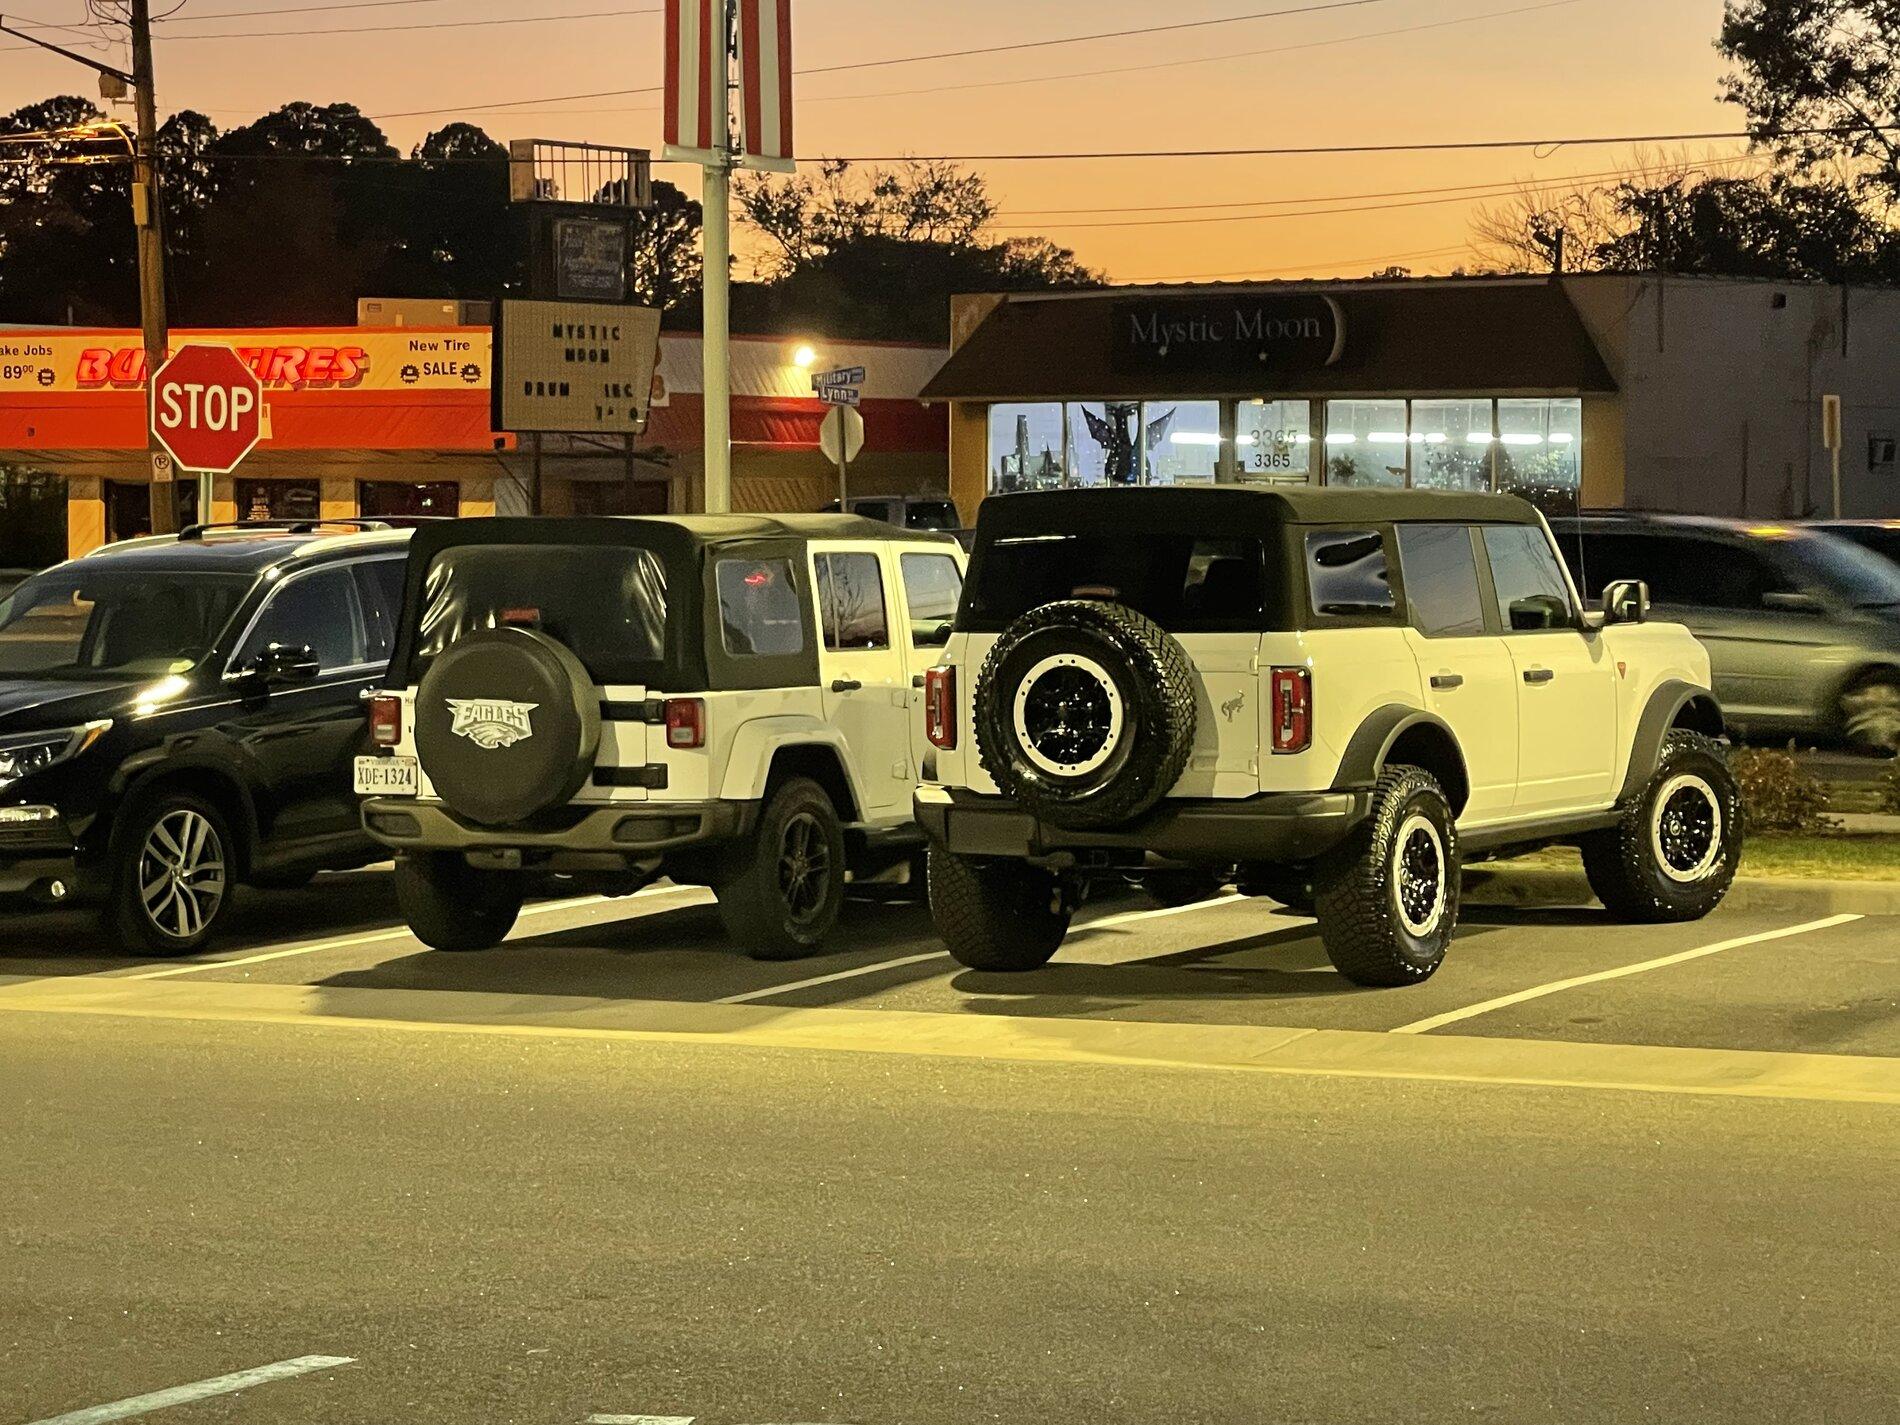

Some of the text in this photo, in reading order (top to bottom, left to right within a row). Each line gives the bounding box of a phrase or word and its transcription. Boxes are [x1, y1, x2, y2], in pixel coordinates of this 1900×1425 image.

[553, 324, 620, 340] MYSTIC
[1131, 304, 1321, 346] Mystic Moon
[24, 345, 52, 356] Jobs
[409, 339, 470, 351] New Tire
[565, 348, 609, 362] MOON
[423, 362, 457, 375] SALE
[524, 381, 569, 396] DRUM
[821, 386, 847, 402] Lynn
[160, 382, 254, 431] STOP
[1254, 453, 1291, 468] 3365
[461, 703, 526, 728] EAGLES
[358, 767, 412, 785] XDE-1324
